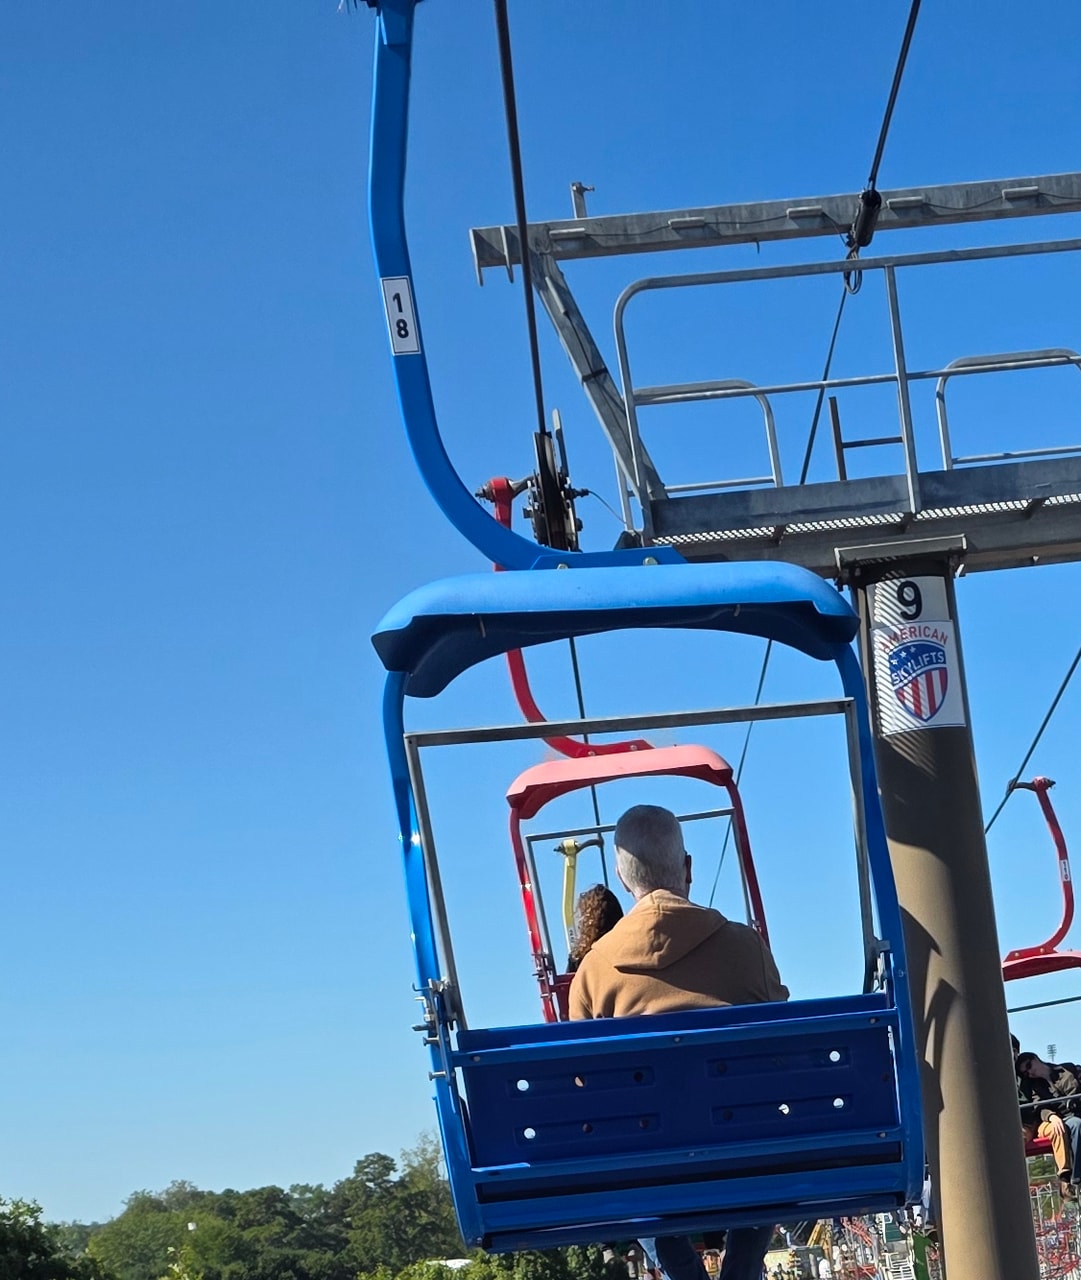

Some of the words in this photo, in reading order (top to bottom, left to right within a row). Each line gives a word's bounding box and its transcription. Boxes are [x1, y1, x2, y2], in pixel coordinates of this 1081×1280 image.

[393, 292, 409, 339] 18
[897, 580, 923, 621] 9
[880, 626, 948, 655] AMERICAN
[891, 651, 946, 685] SKYLIFTS
